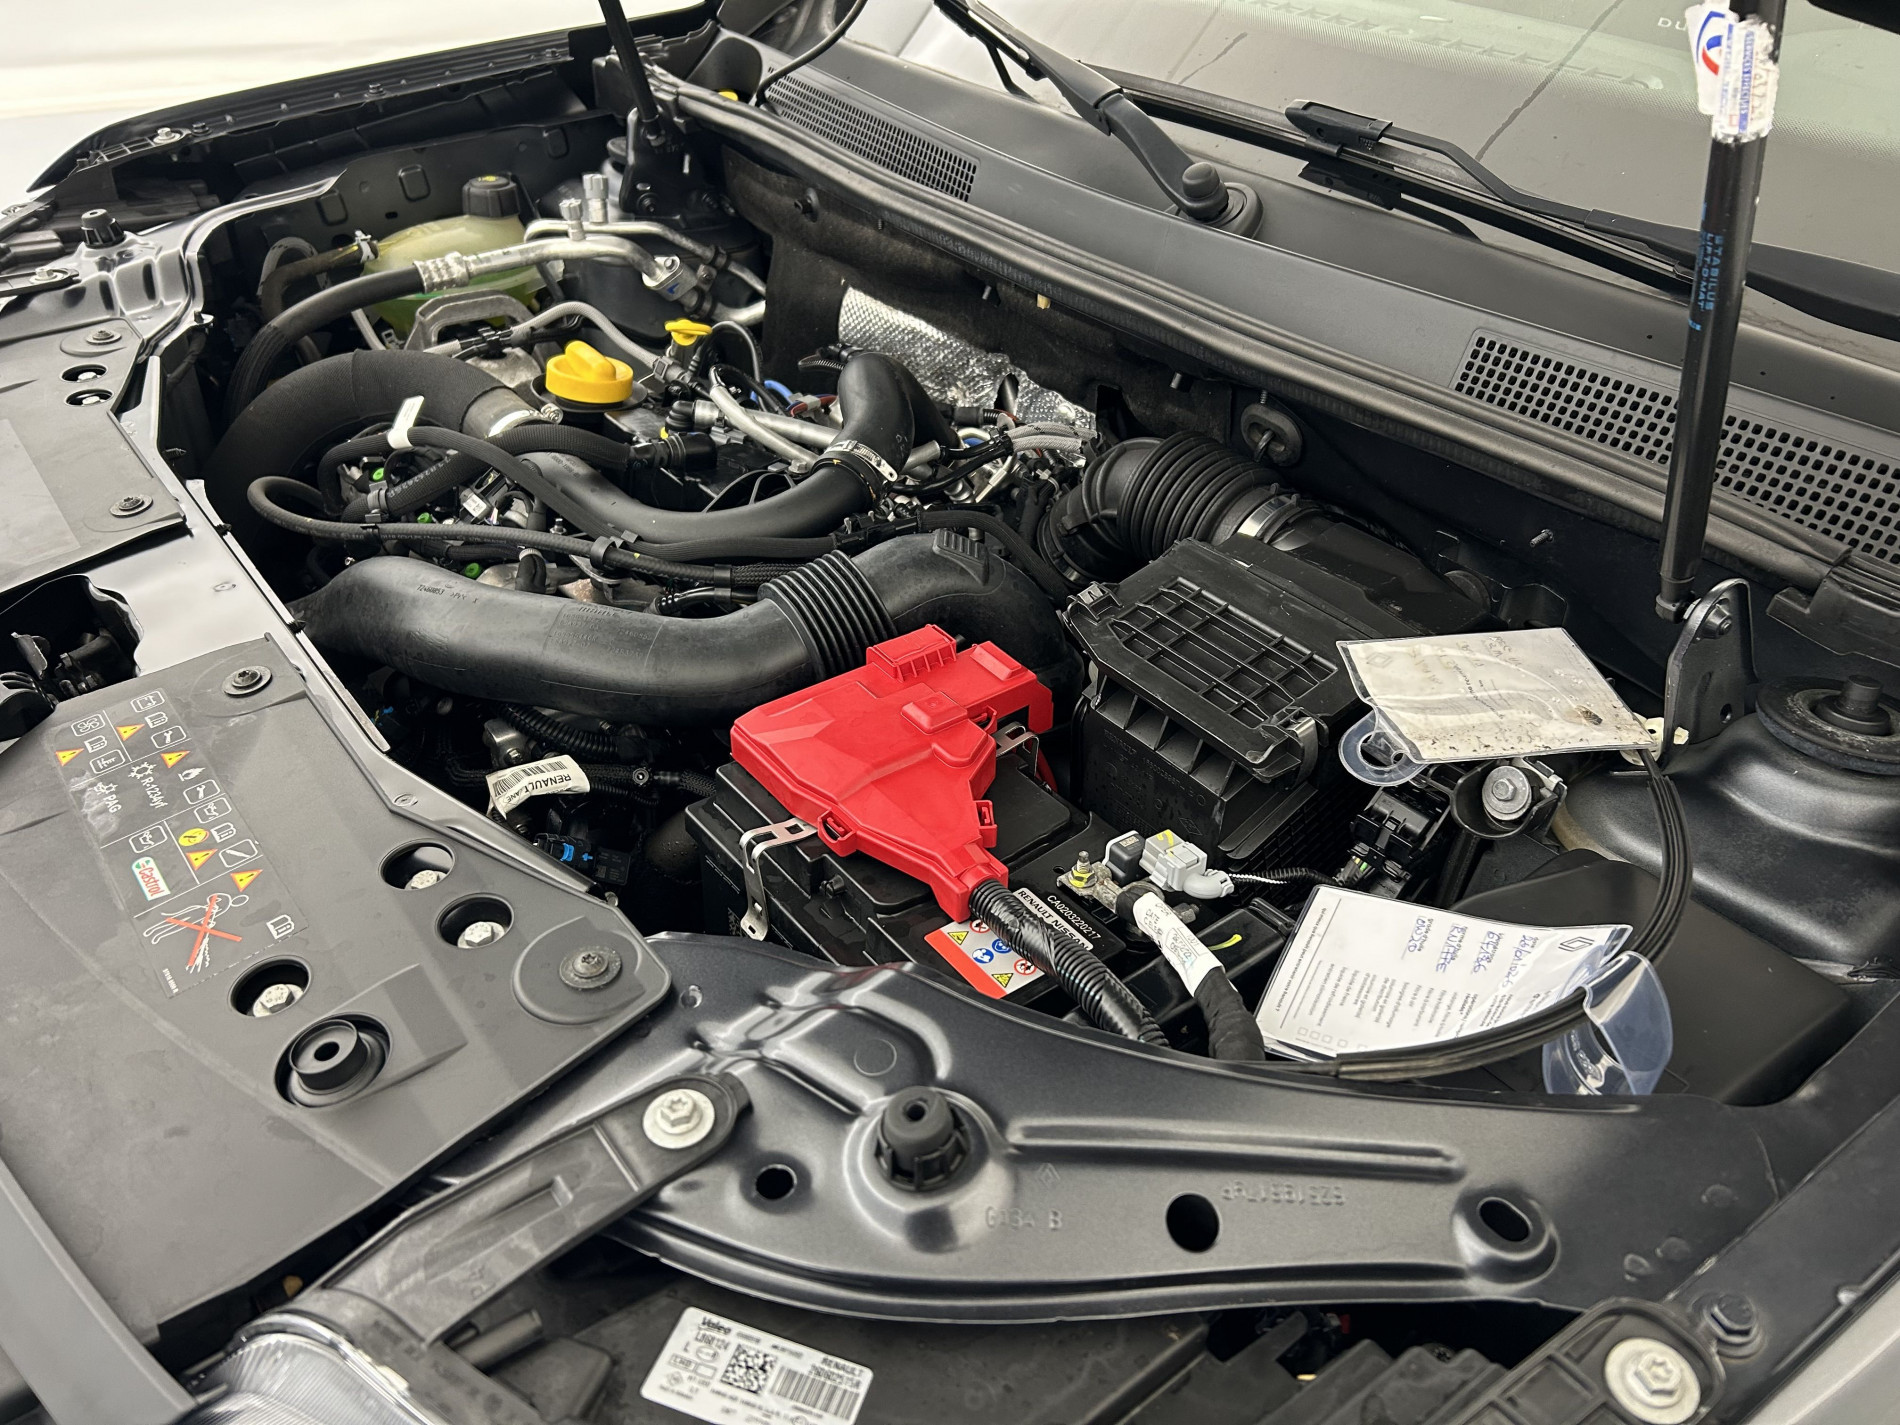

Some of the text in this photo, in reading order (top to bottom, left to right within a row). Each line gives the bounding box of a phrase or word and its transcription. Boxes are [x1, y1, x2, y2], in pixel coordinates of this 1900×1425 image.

[524, 773, 572, 793] RENAULT
[103, 795, 122, 813] PAG
[138, 866, 162, 897] Castrol
[1017, 890, 1054, 926] RENAULT
[701, 1316, 732, 1334] Valeo
[821, 1357, 864, 1378] RENAULT
